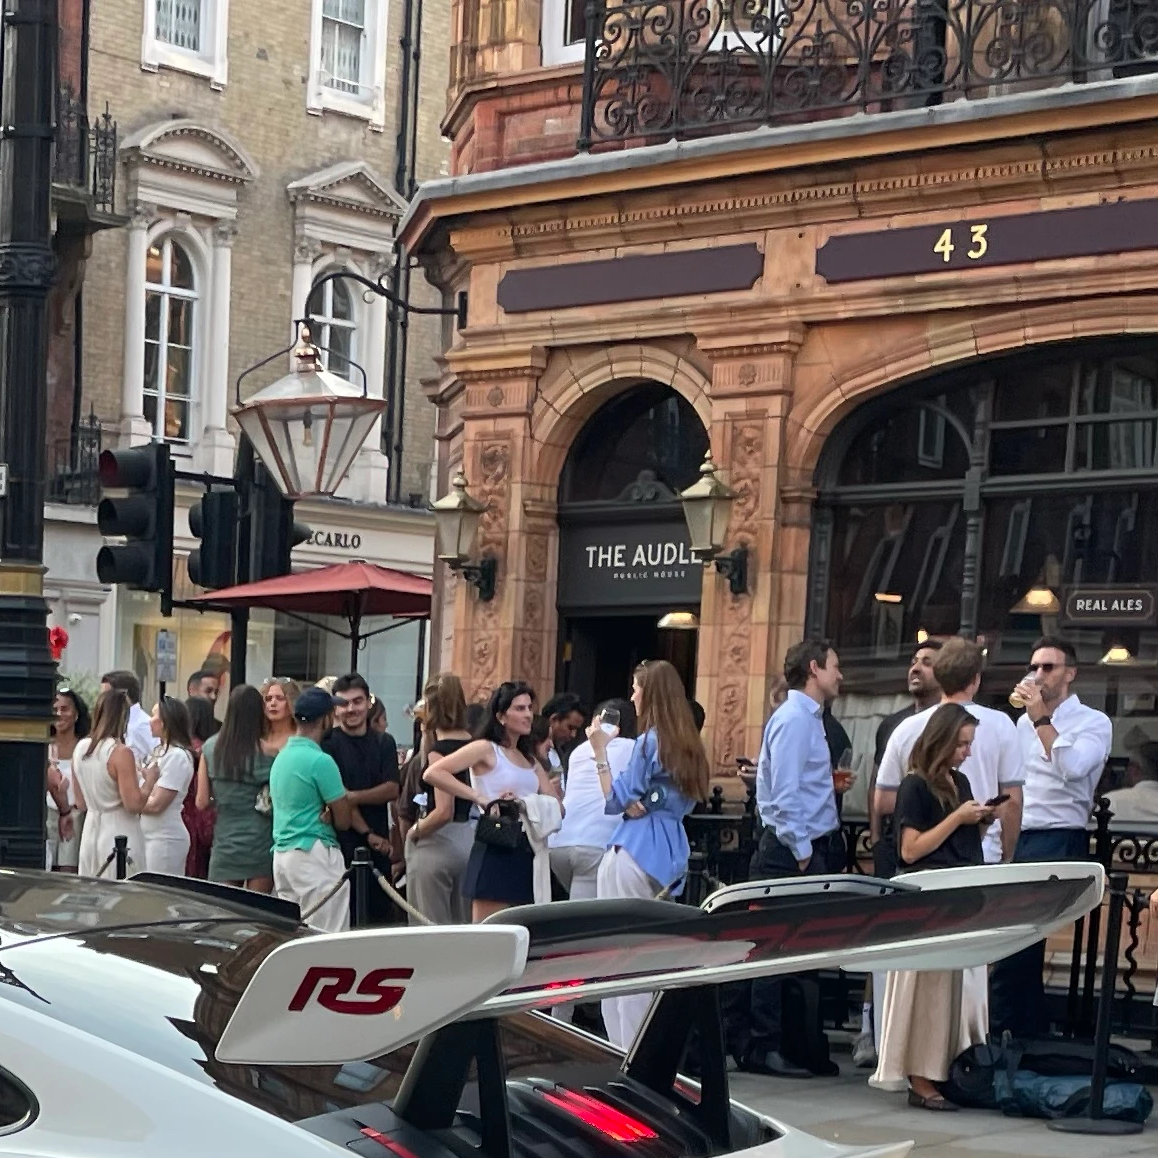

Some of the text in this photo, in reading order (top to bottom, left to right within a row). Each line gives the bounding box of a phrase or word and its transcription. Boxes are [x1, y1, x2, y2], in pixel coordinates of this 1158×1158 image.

[933, 224, 988, 262] 43
[585, 544, 627, 568] THE
[613, 570, 686, 580] PUBLIC HOUSE
[1076, 598, 1143, 611] REAL ALES
[288, 966, 415, 1016] RS
